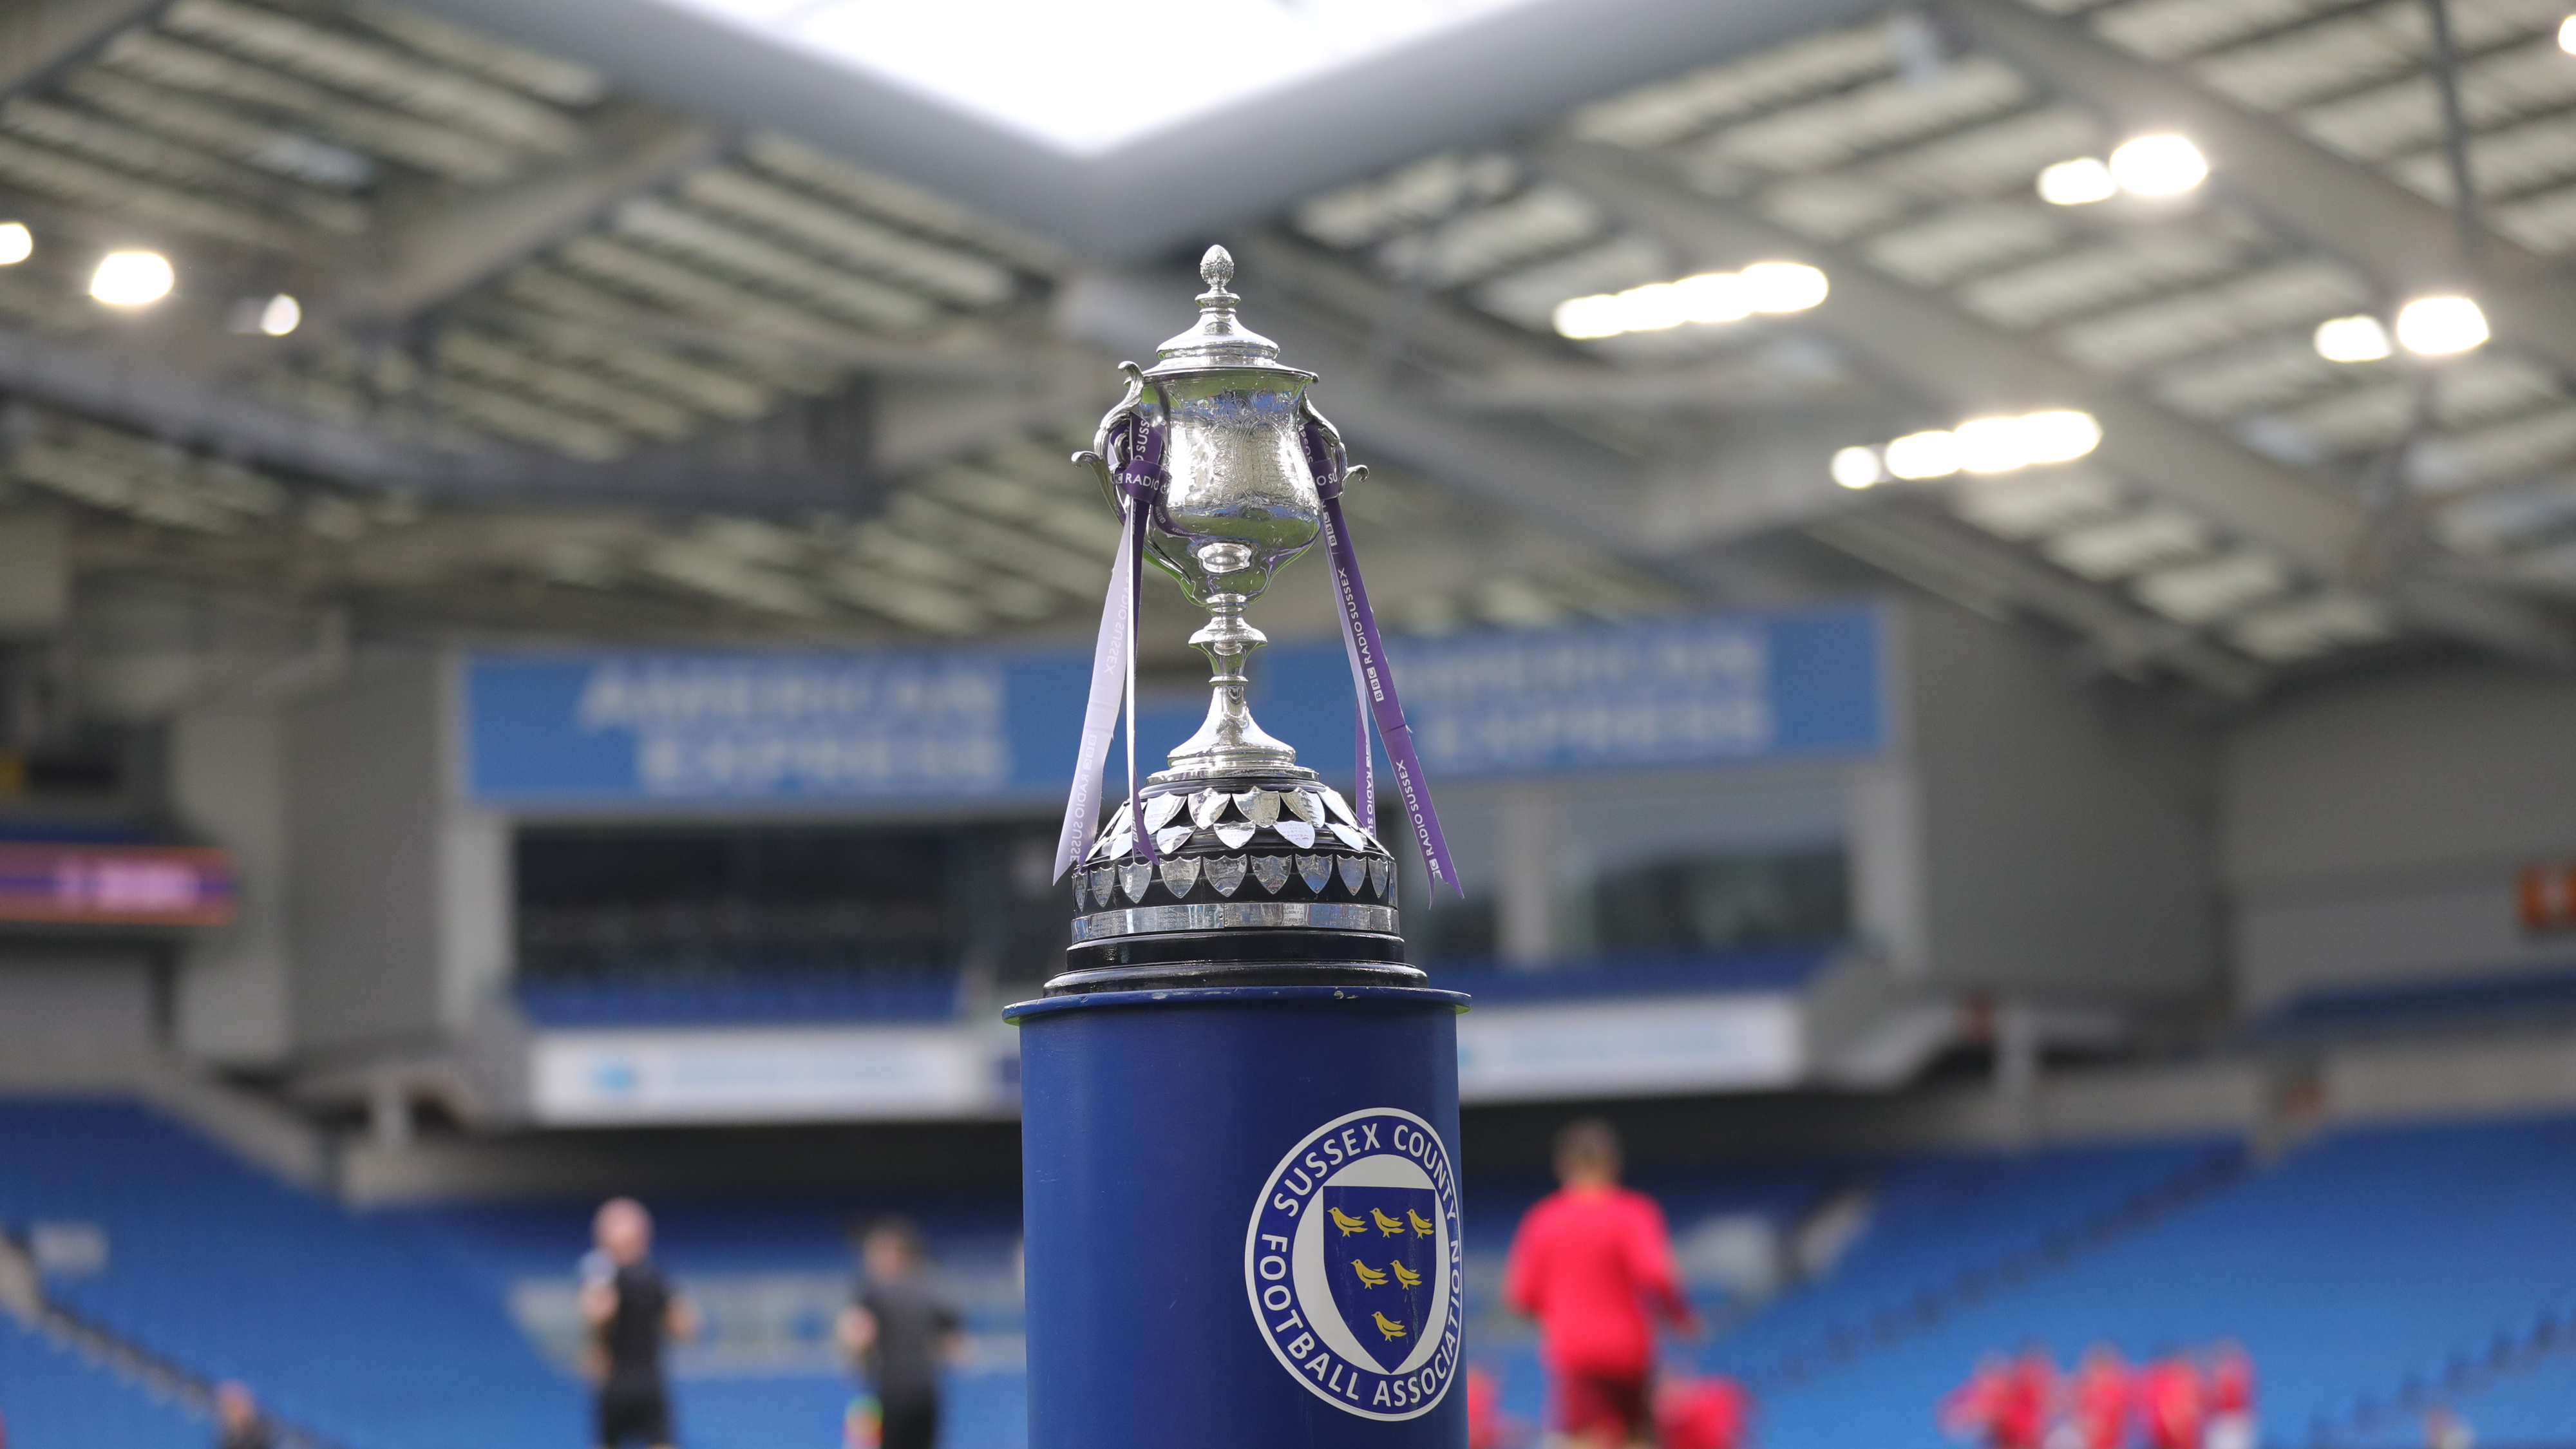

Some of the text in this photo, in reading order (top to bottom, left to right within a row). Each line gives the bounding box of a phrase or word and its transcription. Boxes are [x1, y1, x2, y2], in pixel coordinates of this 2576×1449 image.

[1136, 420, 1150, 452] SUSS
[1338, 567, 1384, 702] BBC RADIO SUSSEX
[1396, 759, 1434, 856] RADIO SUSSEX
[1274, 1122, 1457, 1218] SUSSEX COUNTY
[1260, 1233, 1461, 1407] FOOTBALL ASSOCIATION
